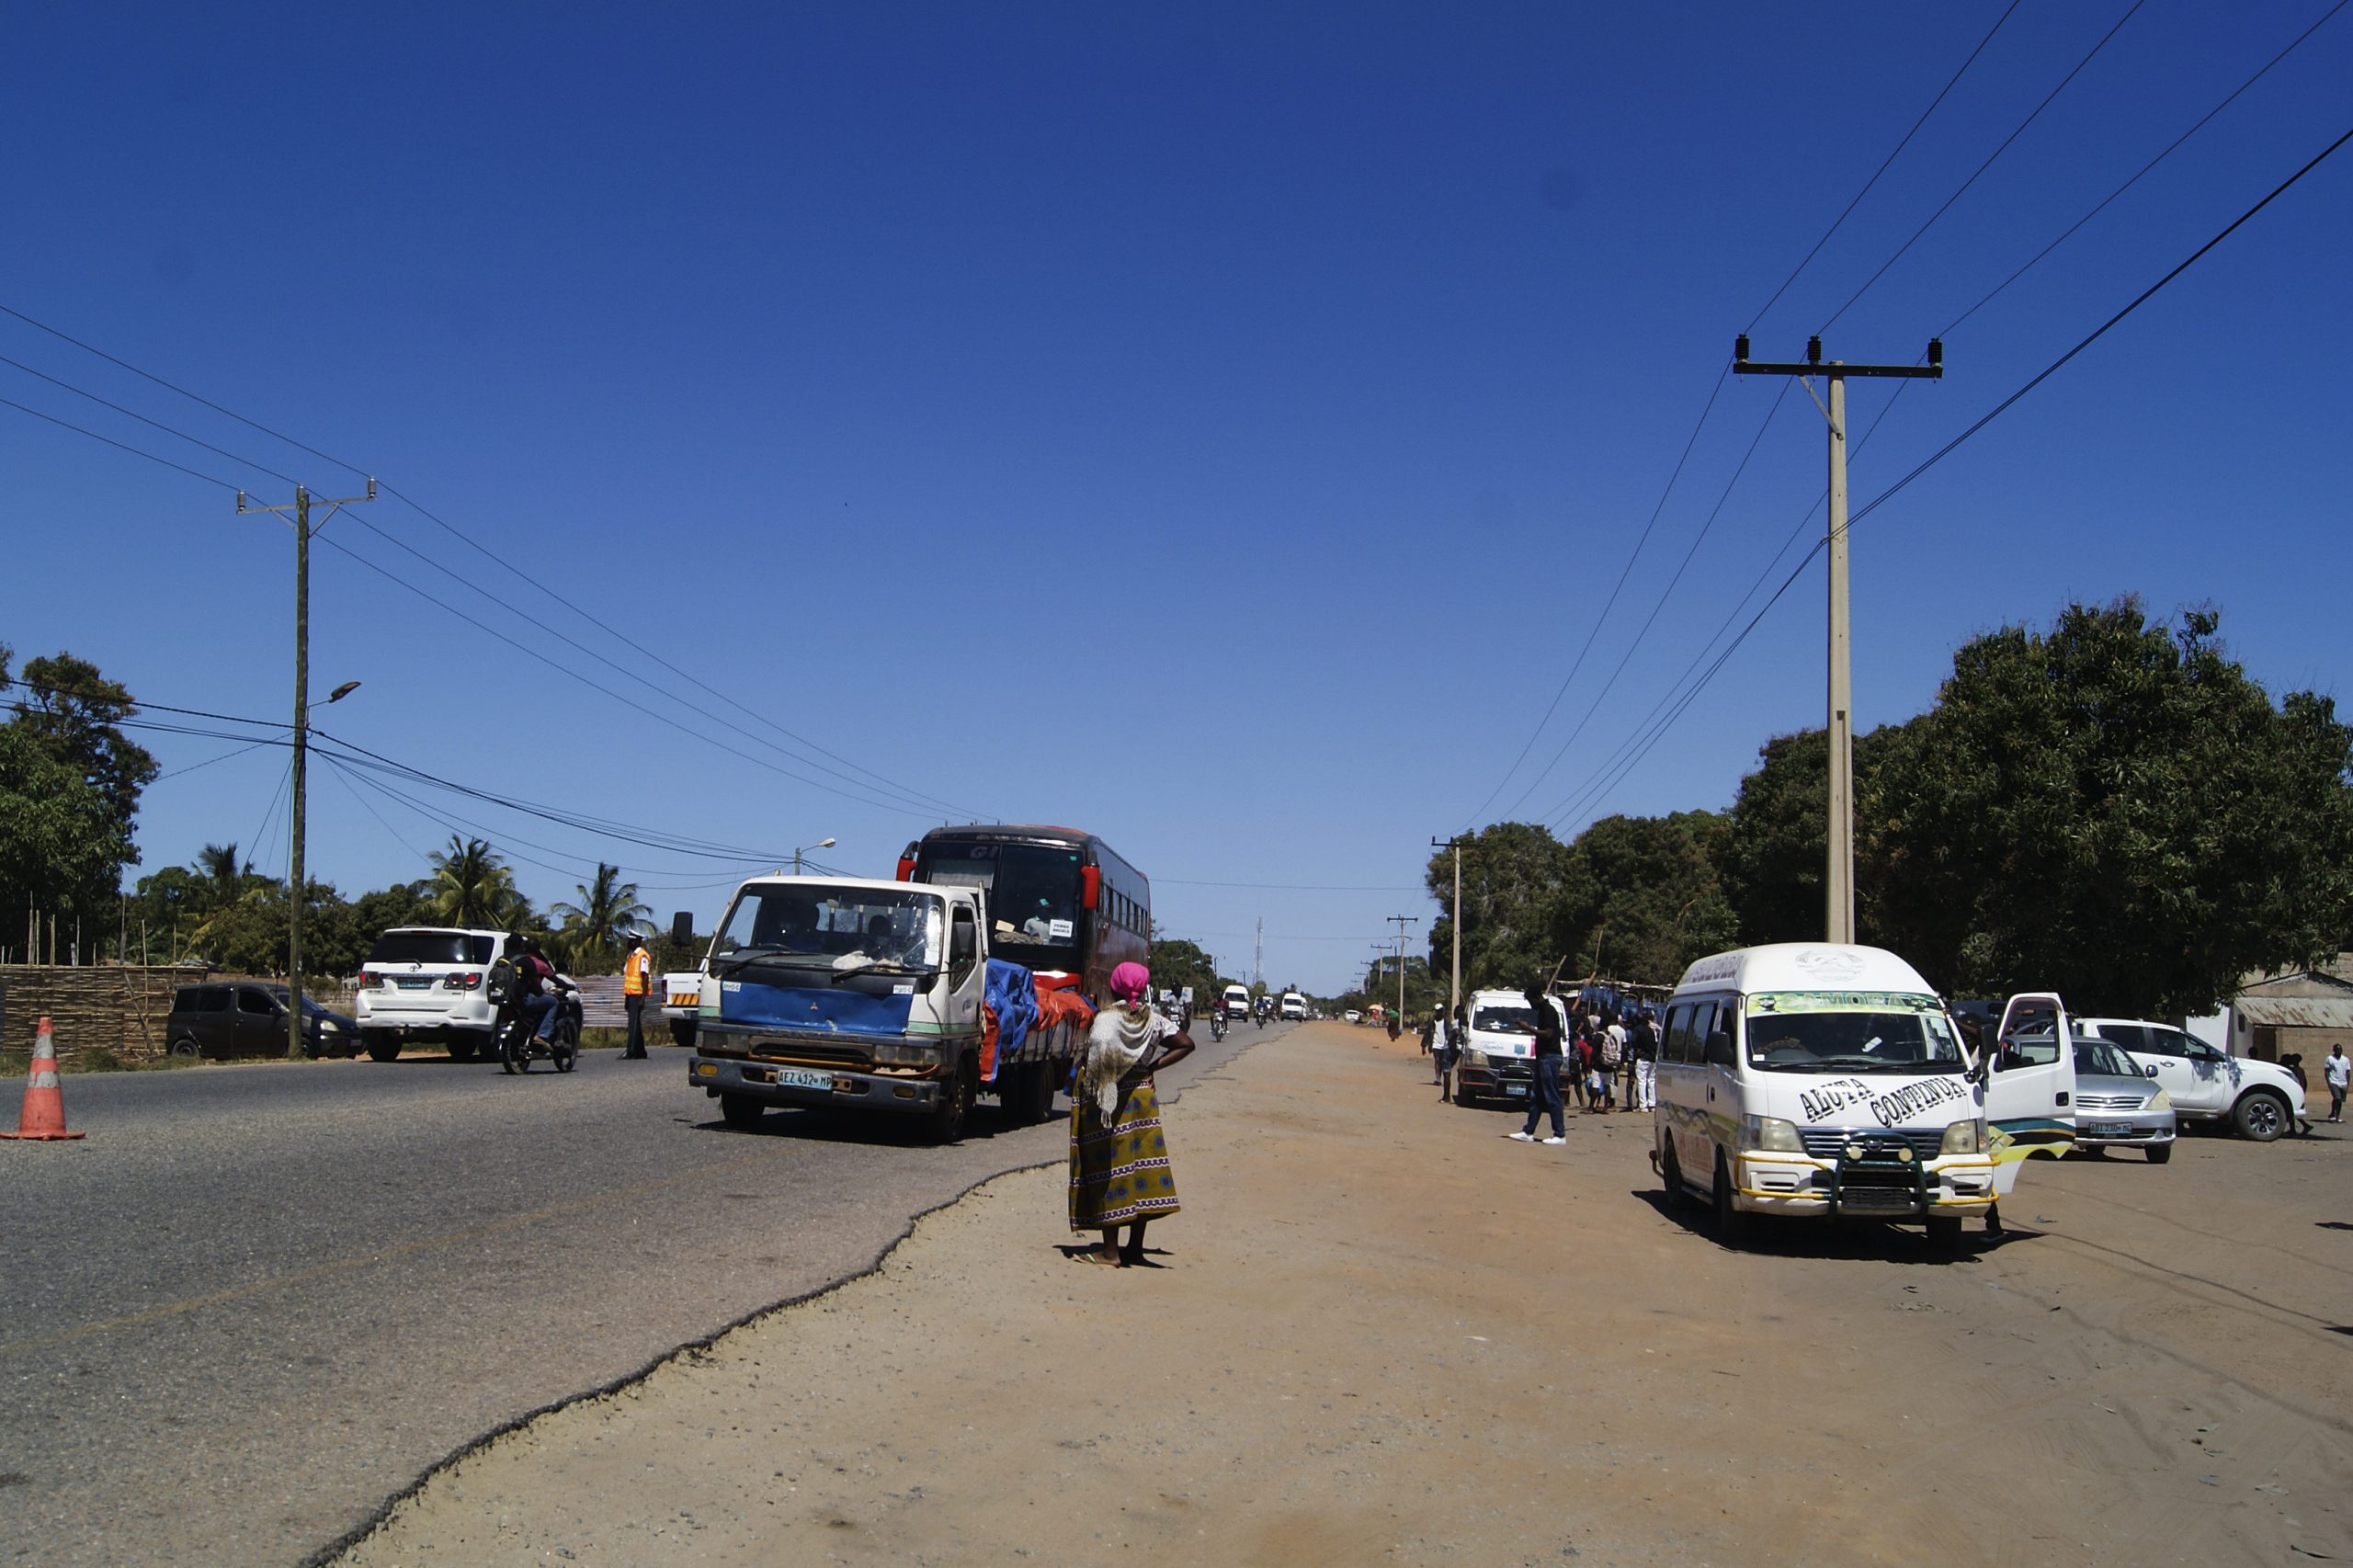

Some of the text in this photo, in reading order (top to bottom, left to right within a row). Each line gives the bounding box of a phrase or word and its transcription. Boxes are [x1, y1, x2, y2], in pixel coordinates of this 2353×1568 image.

[1779, 993, 1908, 1010] SAMORA
[779, 1072, 795, 1085] AEZ
[820, 1076, 832, 1088] MP
[1799, 1075, 1967, 1129] ALUTA CONTINUA
